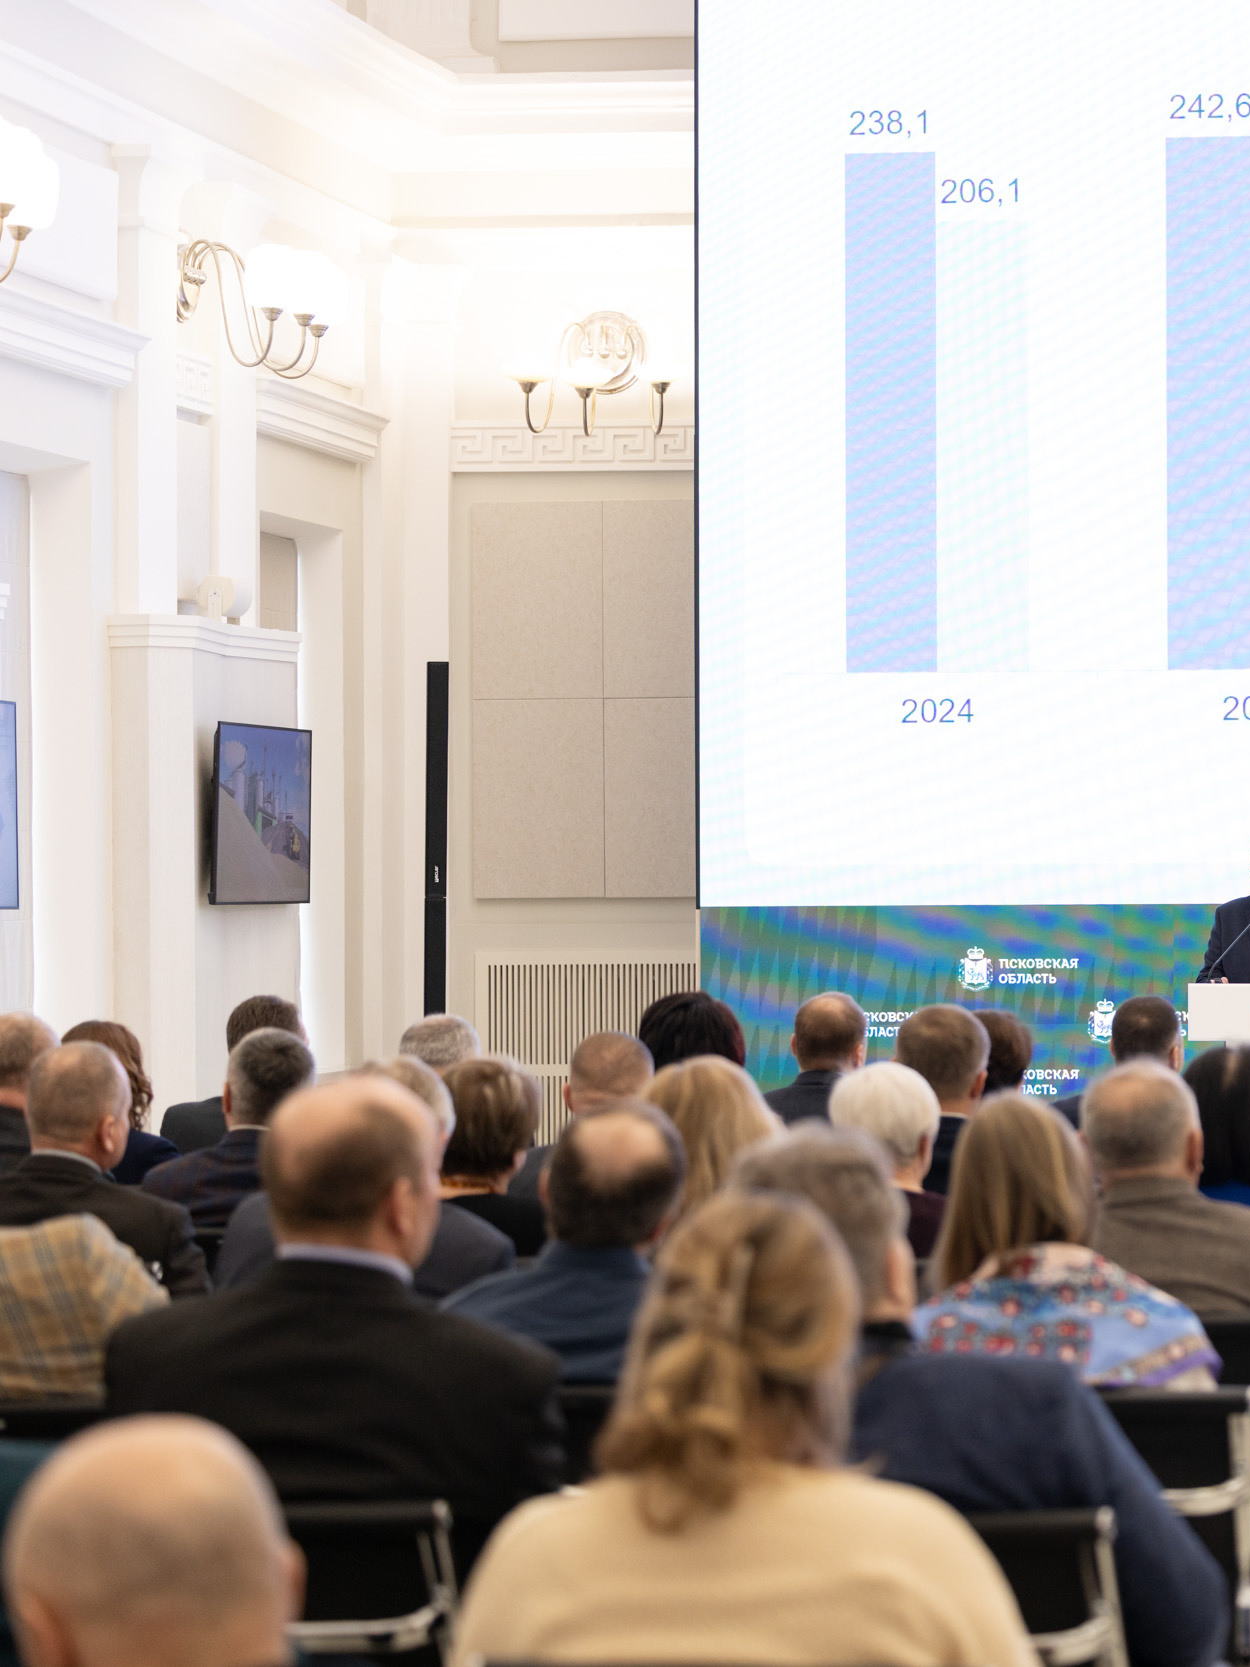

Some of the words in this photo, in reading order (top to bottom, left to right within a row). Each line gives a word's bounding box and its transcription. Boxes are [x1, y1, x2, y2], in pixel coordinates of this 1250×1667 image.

[849, 109, 927, 139] 238,1
[940, 177, 1020, 207] 206,1
[901, 697, 975, 724] 2024
[998, 958, 1079, 969] ПСКОВСКАЯ
[998, 973, 1057, 984] ОБЛАСТЬ
[863, 1011, 918, 1022] СКОВСК
[864, 1026, 900, 1037] ЛАСТ
[1023, 1069, 1080, 1080] ОВСКАЯ
[1021, 1084, 1058, 1095] АСТЬ
